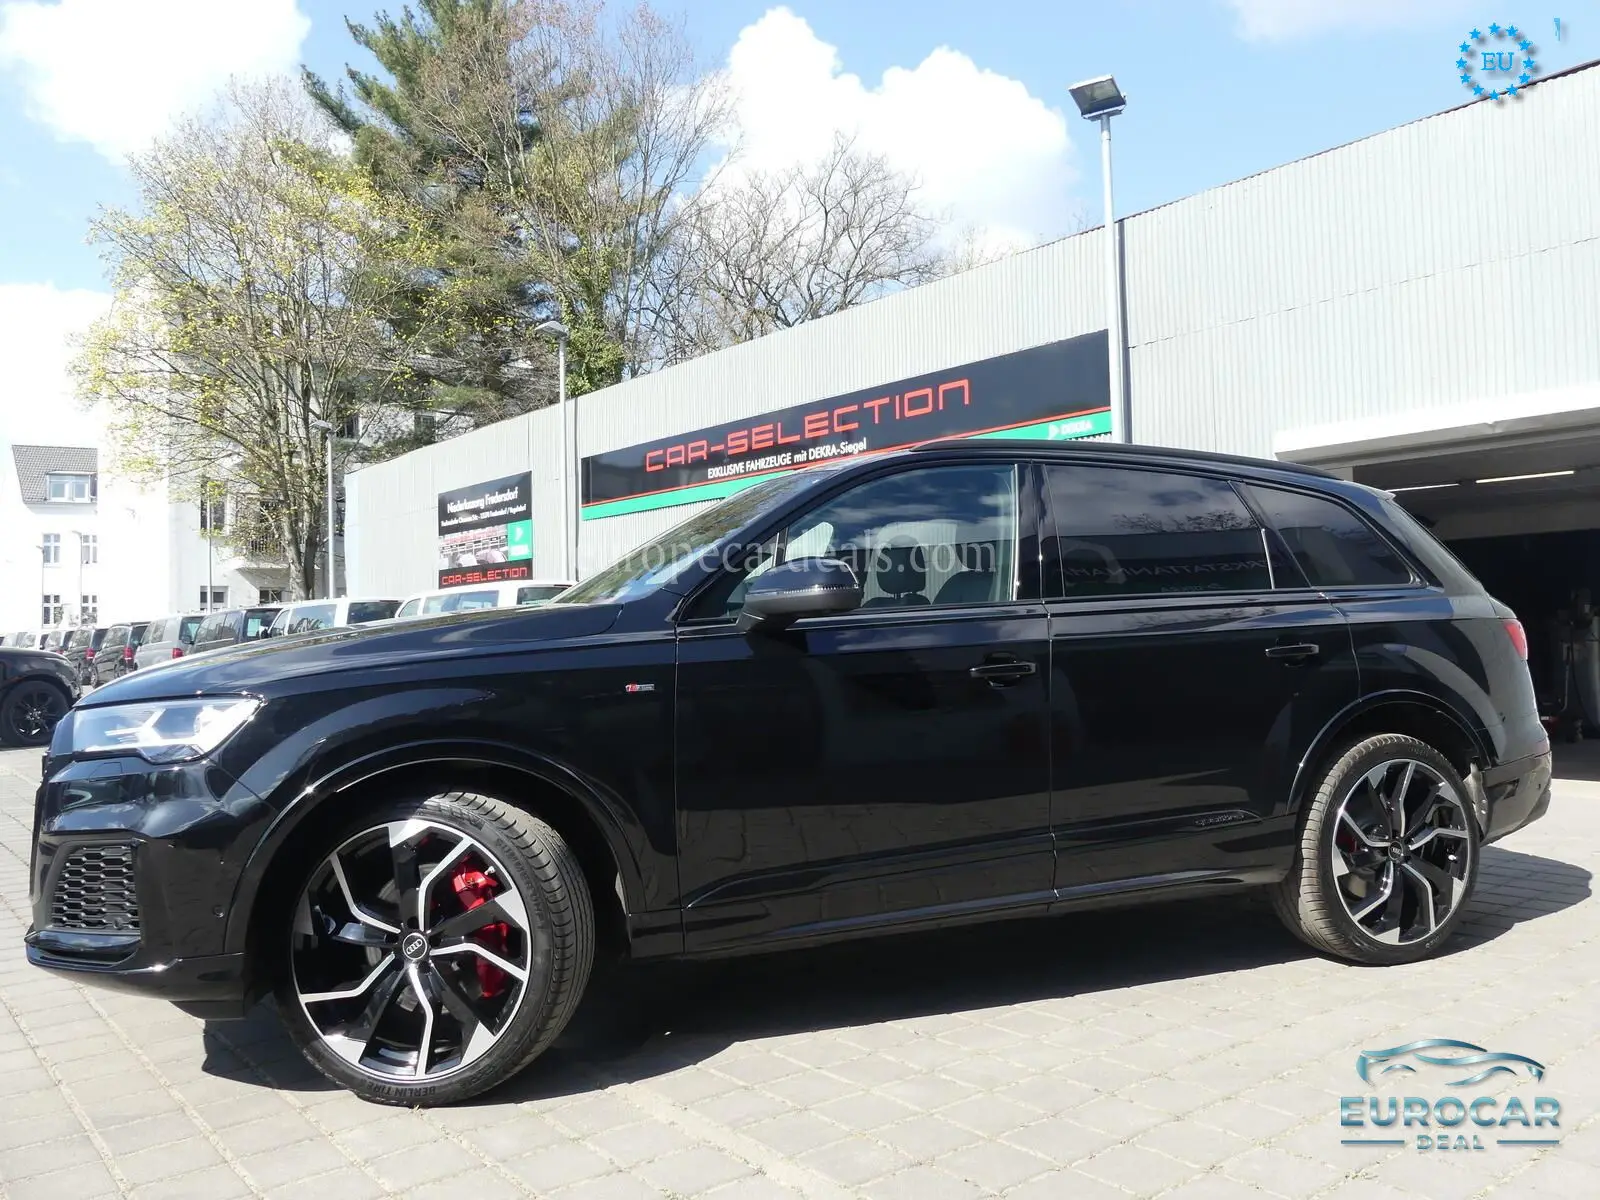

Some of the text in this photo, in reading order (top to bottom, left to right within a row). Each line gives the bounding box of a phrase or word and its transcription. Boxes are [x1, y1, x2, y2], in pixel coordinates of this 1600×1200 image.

[645, 379, 970, 473] CAR-SELECTION
[707, 437, 867, 479] EXKLUSIVE FAHRZEUGE mit DEKRA-Siegel
[441, 566, 528, 586] CAR-SELECTION
[394, 1085, 437, 1097] BERLIN
